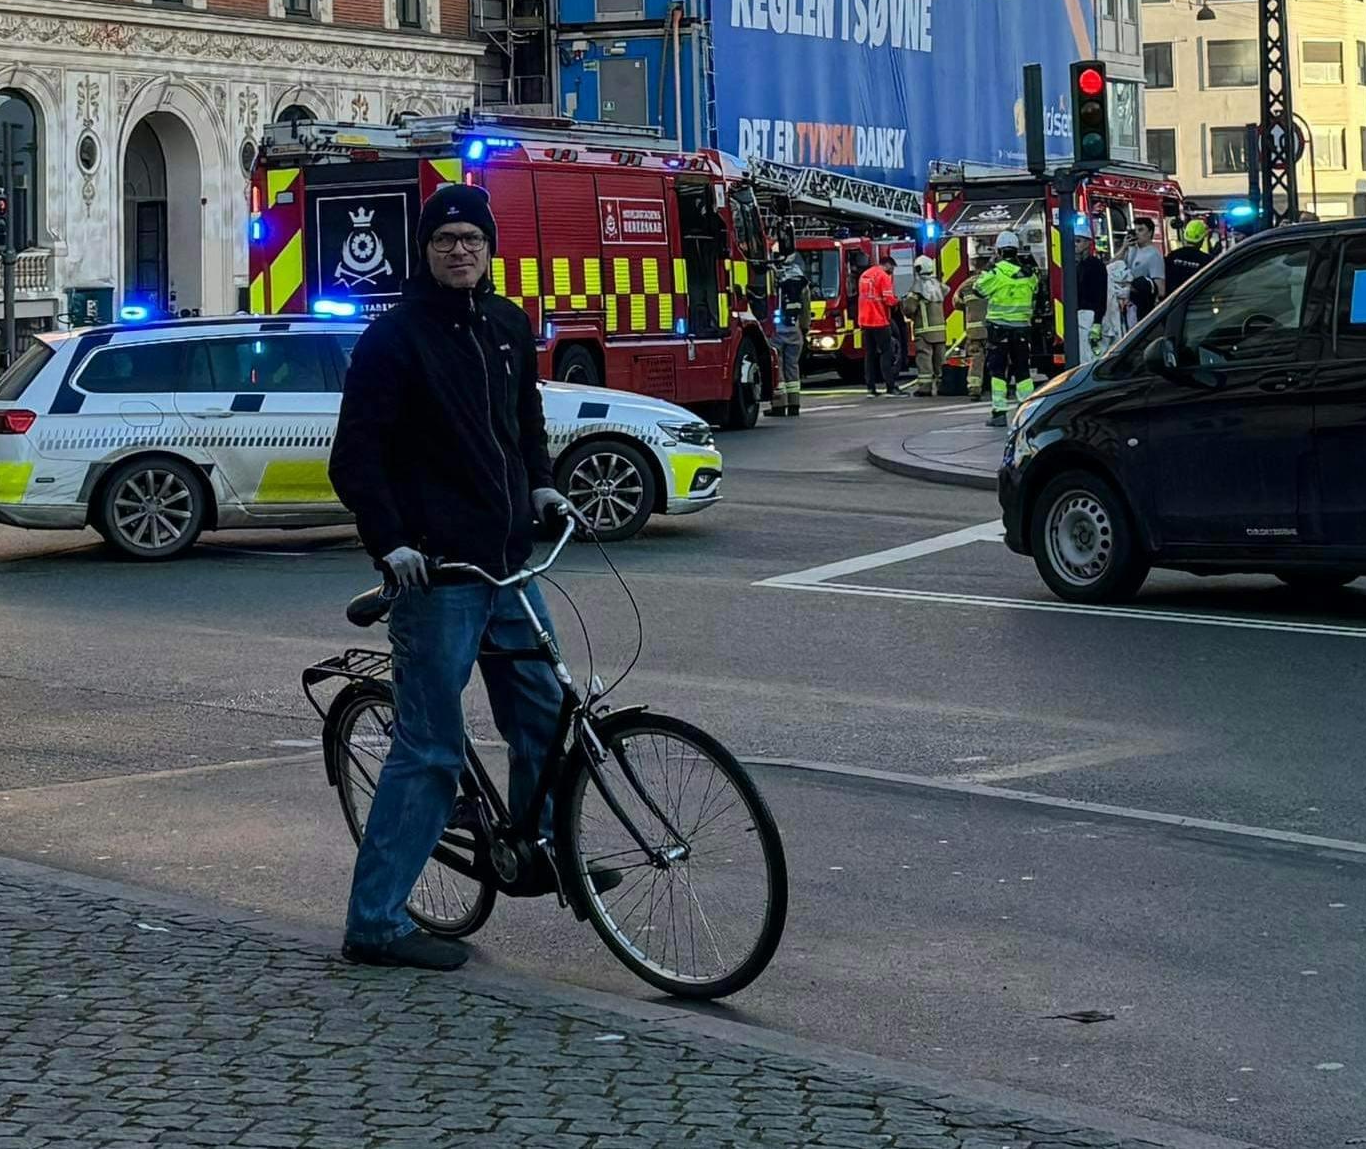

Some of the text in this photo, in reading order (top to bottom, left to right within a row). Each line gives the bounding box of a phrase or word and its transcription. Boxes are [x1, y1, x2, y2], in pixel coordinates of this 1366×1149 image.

[738, 118, 771, 163] DET
[773, 120, 795, 165] ER
[856, 125, 907, 169] DANSK
